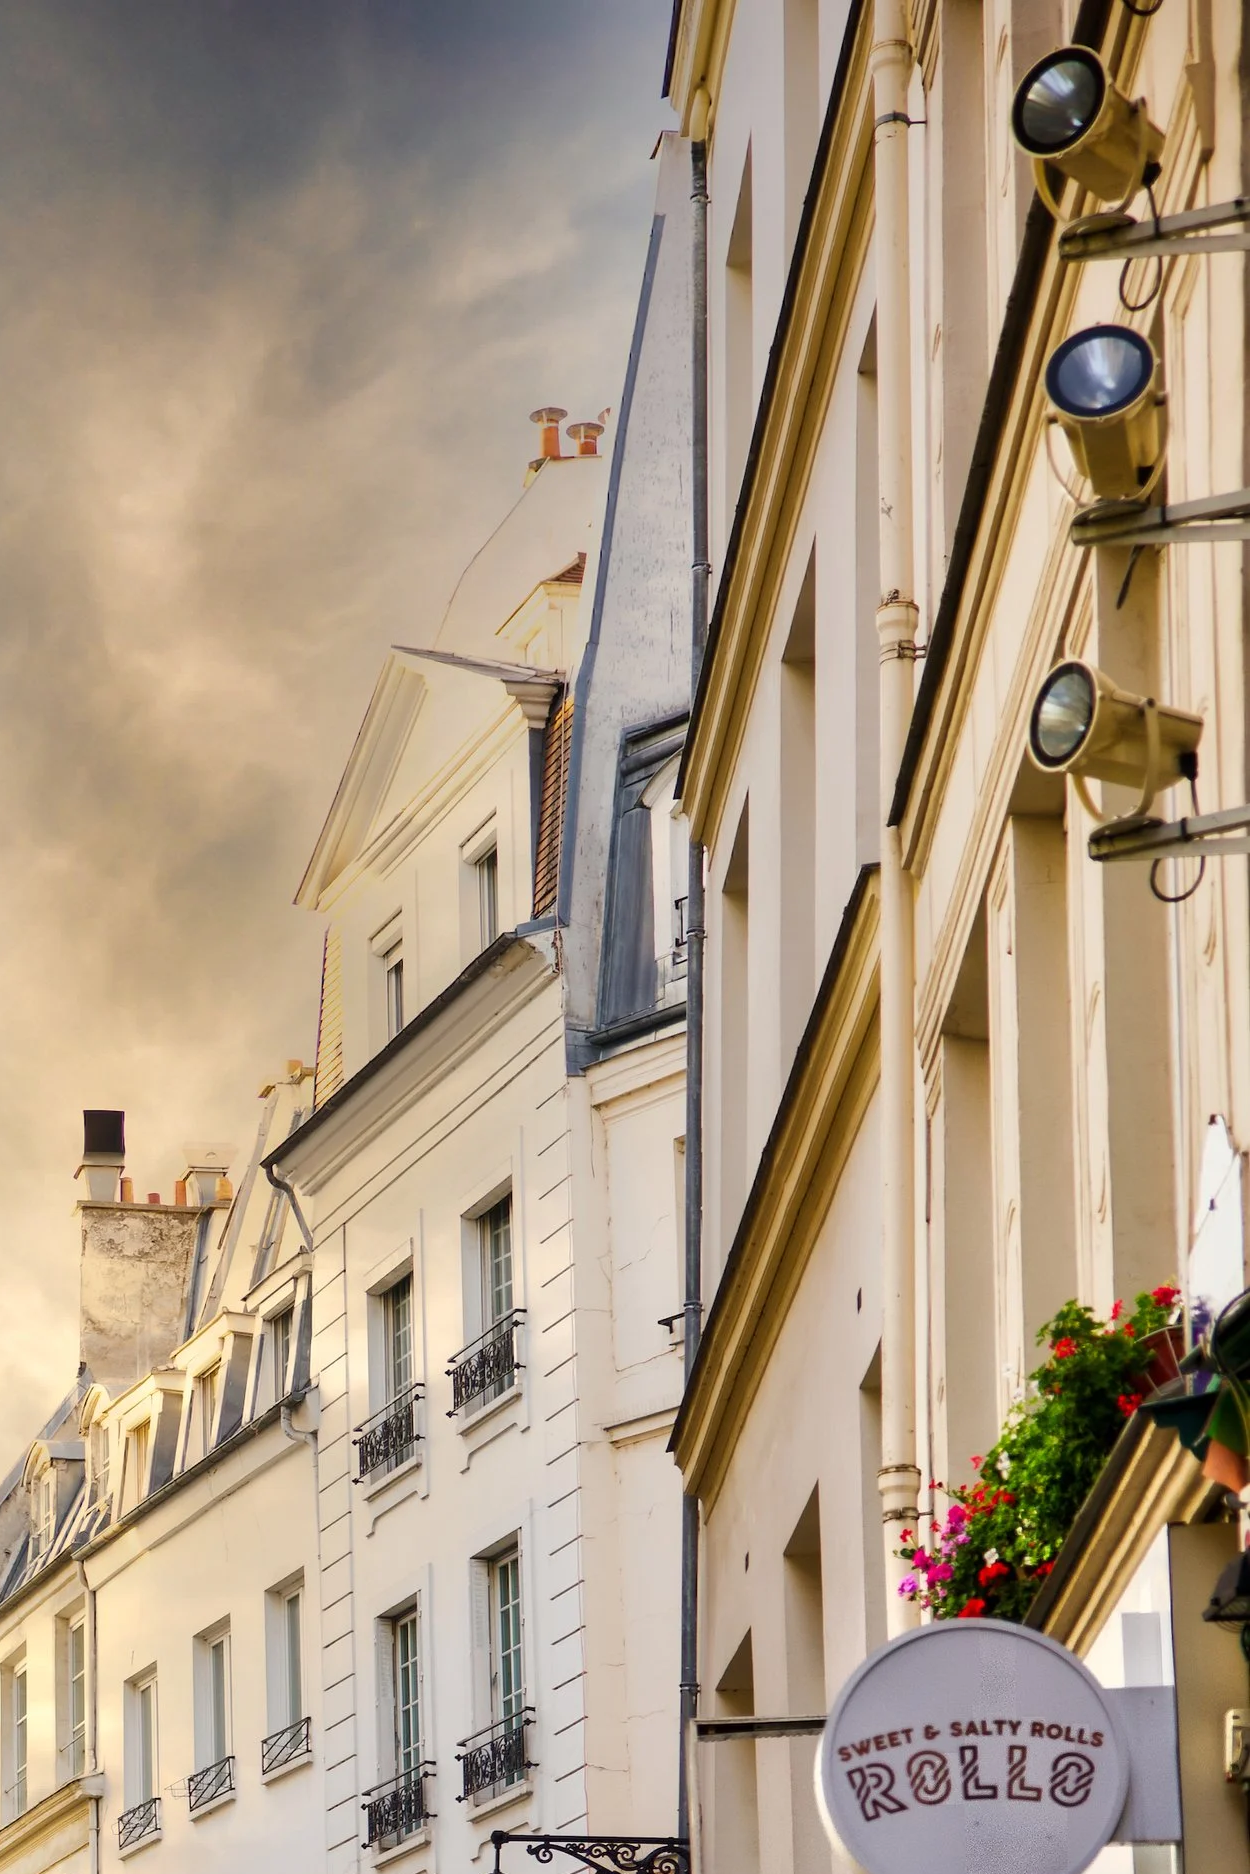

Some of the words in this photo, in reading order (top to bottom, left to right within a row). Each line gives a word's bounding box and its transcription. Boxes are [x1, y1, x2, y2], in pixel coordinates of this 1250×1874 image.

[838, 1728, 913, 1762] SWEET
[950, 1719, 1022, 1738] SALTY
[1030, 1721, 1104, 1747] ROLLS
[847, 1745, 1095, 1821] ROLLO
